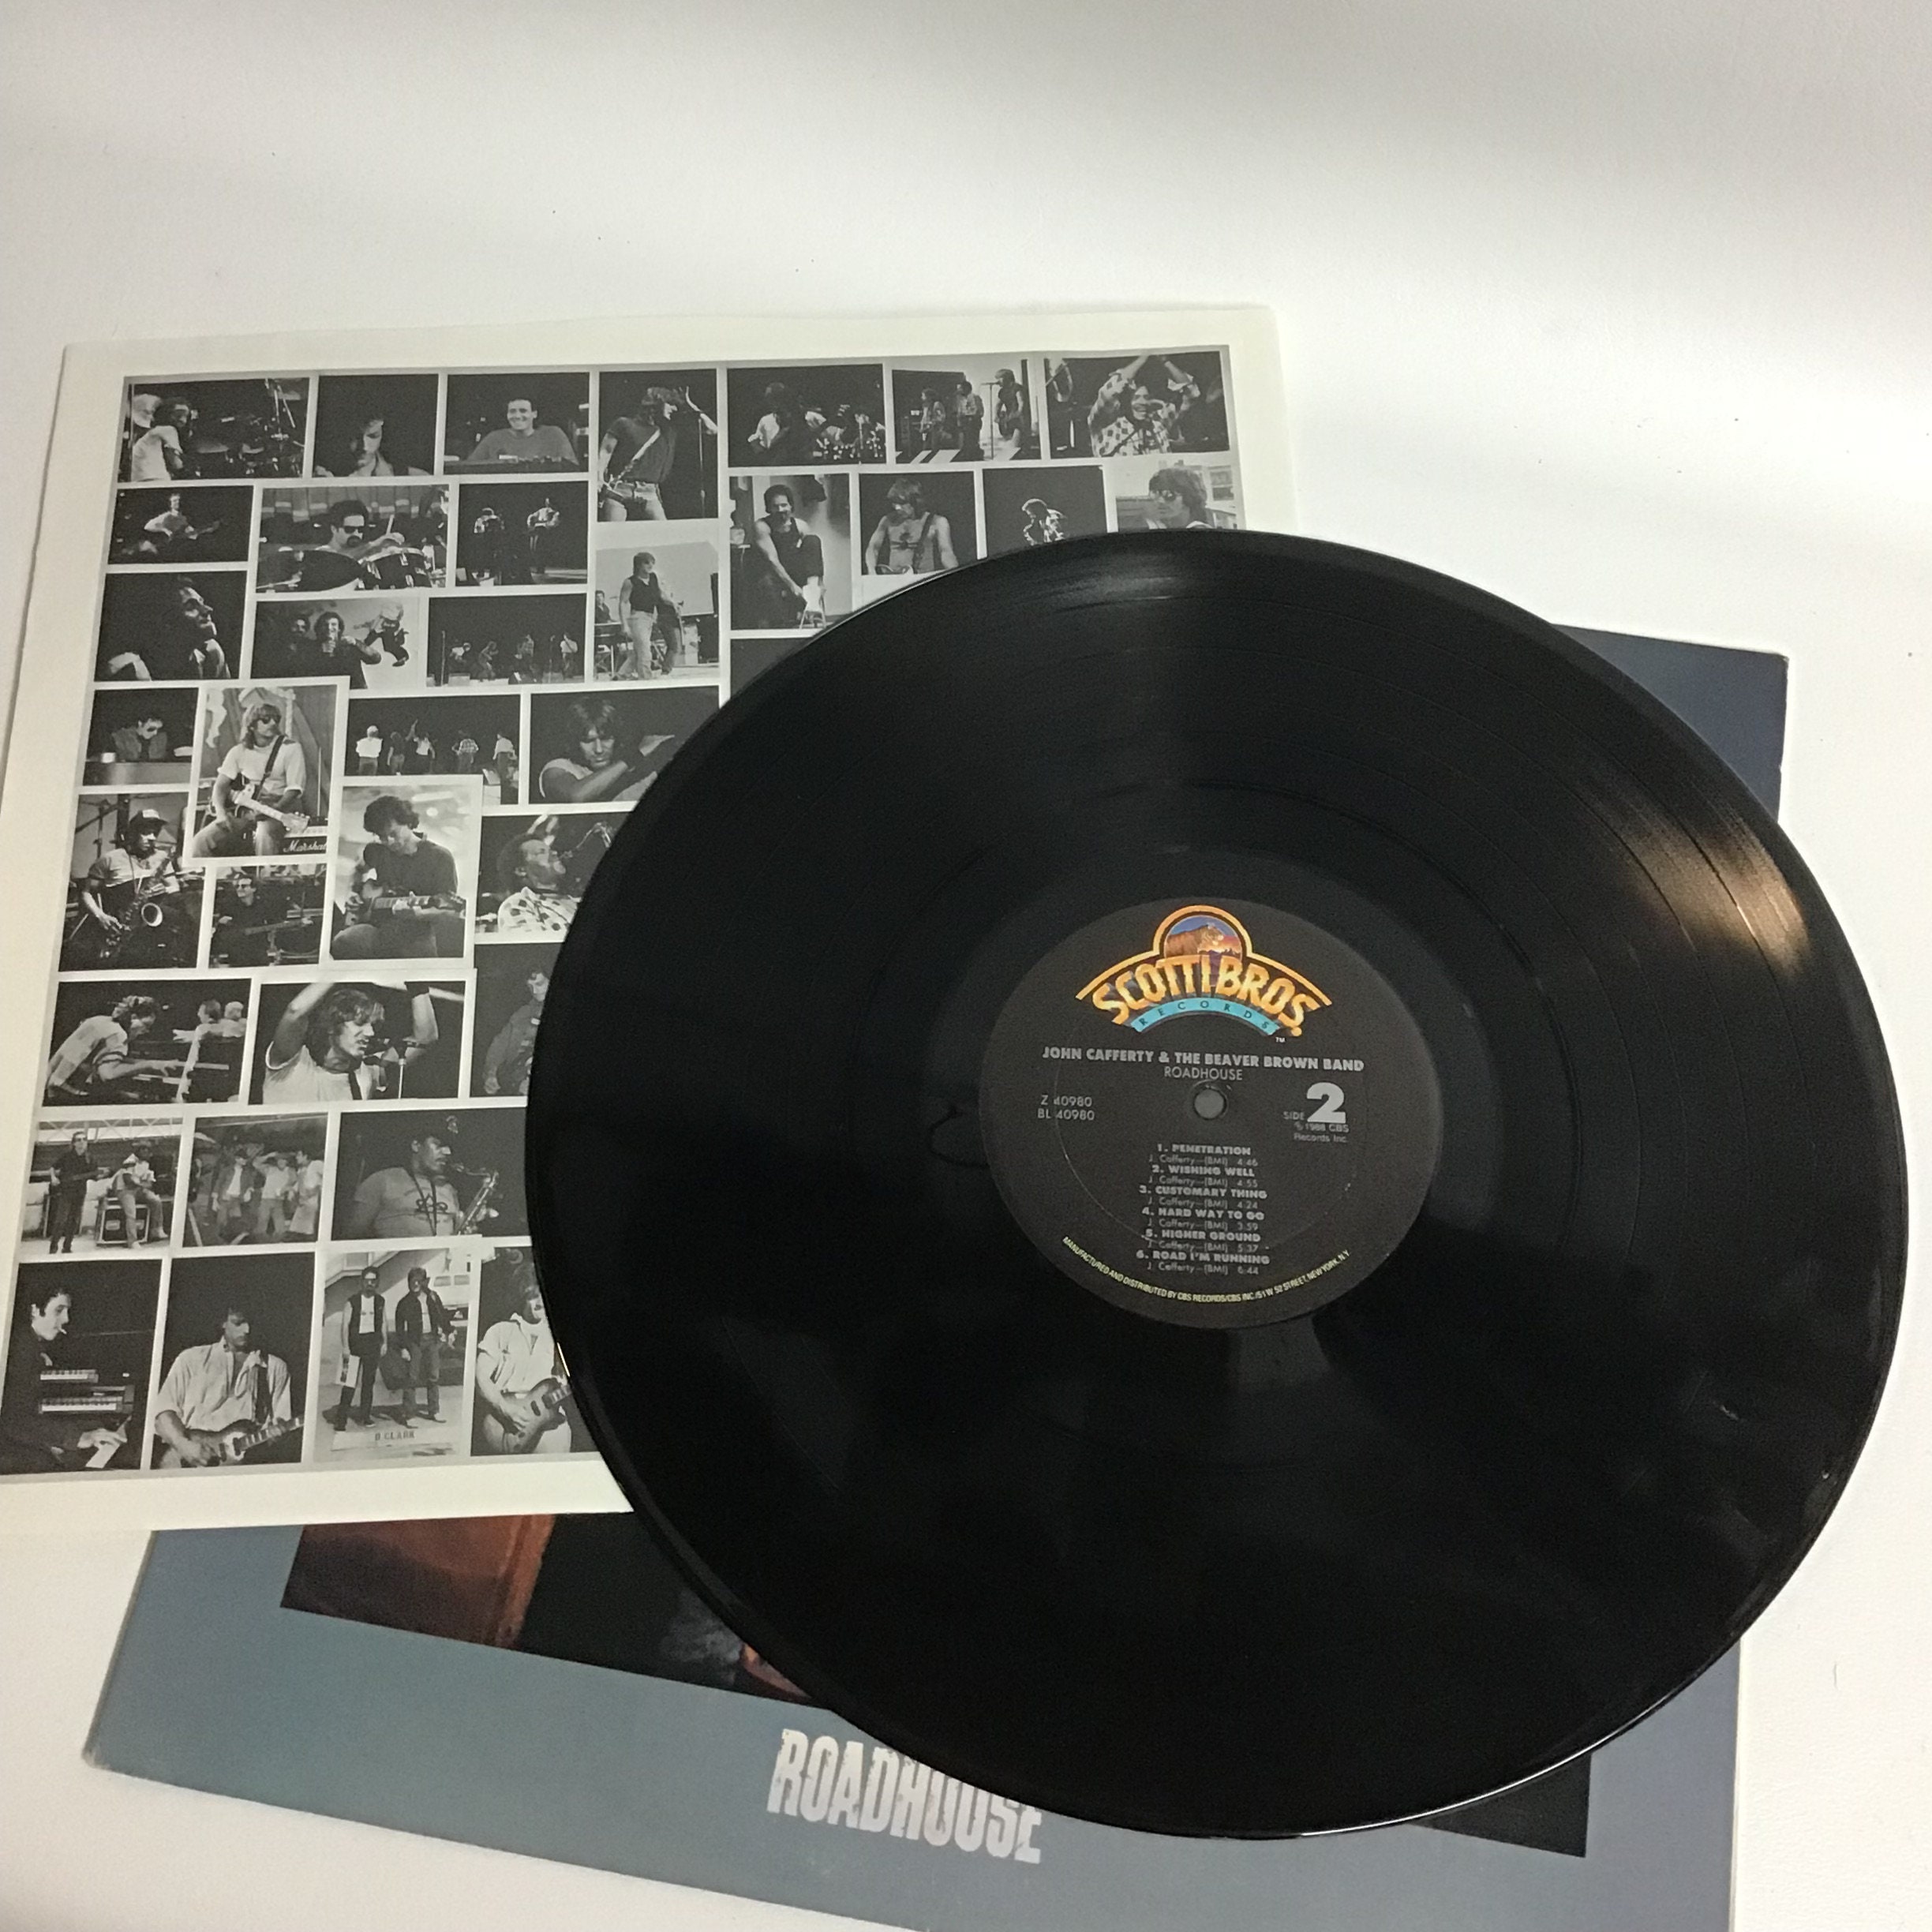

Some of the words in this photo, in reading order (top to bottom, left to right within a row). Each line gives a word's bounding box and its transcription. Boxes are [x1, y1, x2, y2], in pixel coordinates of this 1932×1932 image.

[283, 840, 327, 852] Marsha
[1139, 999, 1269, 1030] RECORDS
[1042, 1046, 1082, 1059] JOHN
[1086, 1048, 1154, 1062] CAFFERTY
[1159, 1051, 1170, 1063] &
[1174, 1052, 1200, 1065] THE
[1204, 1054, 1260, 1067] BEAVER
[1264, 1056, 1319, 1069] BROWN
[1323, 1058, 1365, 1072] BAND
[1164, 1066, 1243, 1080] ROADHOUSE
[1040, 1095, 1048, 1105] Z
[1054, 1095, 1092, 1107] 40980
[1283, 1111, 1305, 1120] SIDE
[1306, 1082, 1346, 1124] 2
[1038, 1108, 1051, 1119] BL
[1056, 1109, 1095, 1121] 40980
[1328, 1124, 1350, 1133] CBS
[1294, 1133, 1331, 1142] Records
[1172, 1144, 1251, 1155] PENETRATION
[1168, 1165, 1221, 1175] WISHING
[1225, 1167, 1255, 1177] WELL
[1139, 1185, 1151, 1194] 3.
[1155, 1186, 1226, 1196] CUSTOMARY
[1230, 1189, 1267, 1199] THING
[1142, 1207, 1155, 1215] 4.
[1159, 1208, 1192, 1217] HARD
[1195, 1209, 1224, 1219] WAY
[1227, 1211, 1243, 1219] TO
[1246, 1211, 1264, 1220] GO
[1162, 1230, 1206, 1240] HIGHER
[1209, 1231, 1261, 1242] GROUND
[1152, 1250, 1187, 1260] ROAD
[1190, 1252, 1211, 1262] I'M
[1214, 1254, 1271, 1264] RUNNING
[1062, 1236, 1110, 1275] MANUFACTURED
[1108, 1270, 1124, 1282] AND
[1123, 1276, 1166, 1297] DISTRIBUTED
[1167, 1290, 1178, 1299] BY
[766, 1728, 1043, 1864] ROADHOUSE
